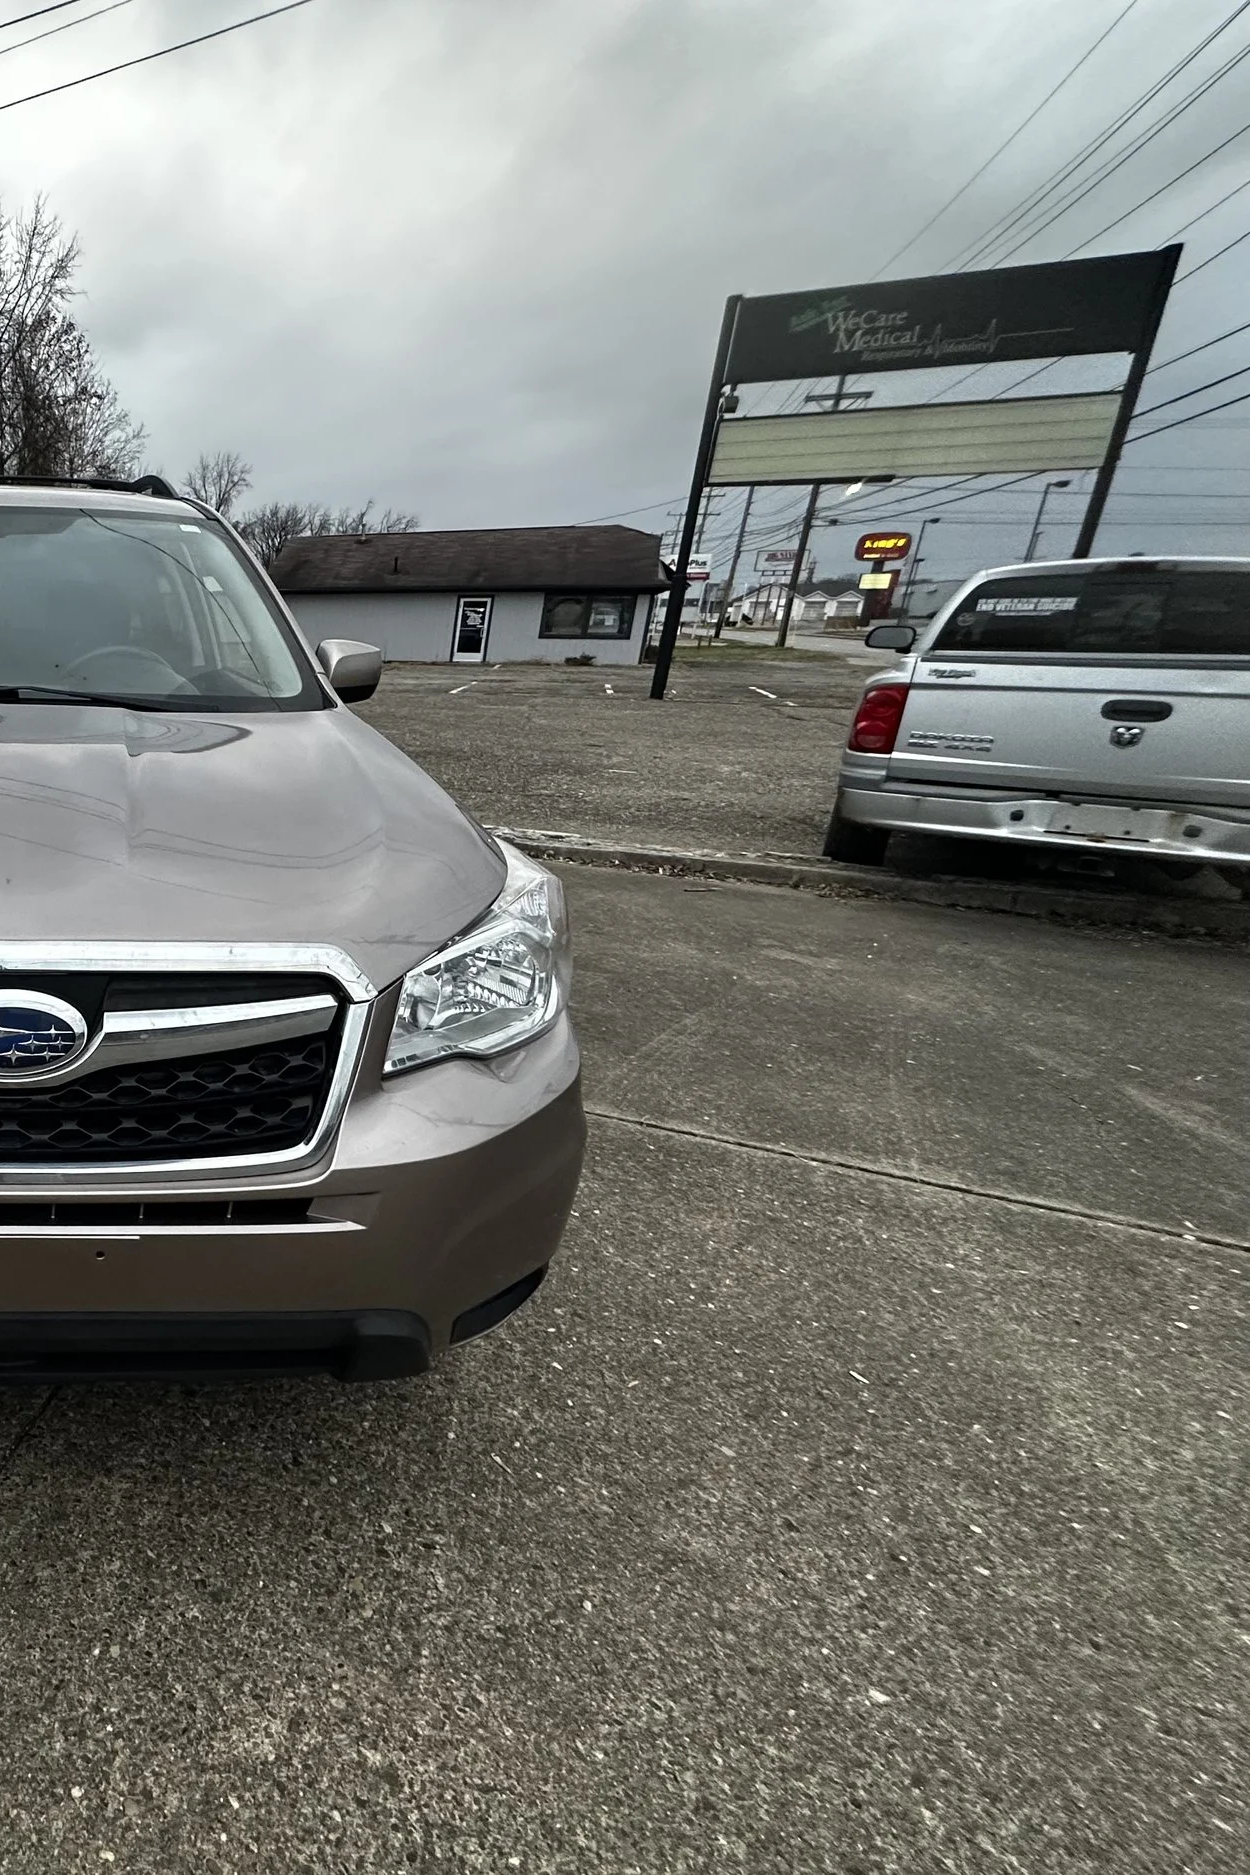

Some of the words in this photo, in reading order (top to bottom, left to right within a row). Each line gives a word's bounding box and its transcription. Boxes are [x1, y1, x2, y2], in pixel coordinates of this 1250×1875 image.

[827, 309, 908, 334] WeCare
[833, 325, 921, 354] Medical
[909, 730, 994, 743] DAKOTA
